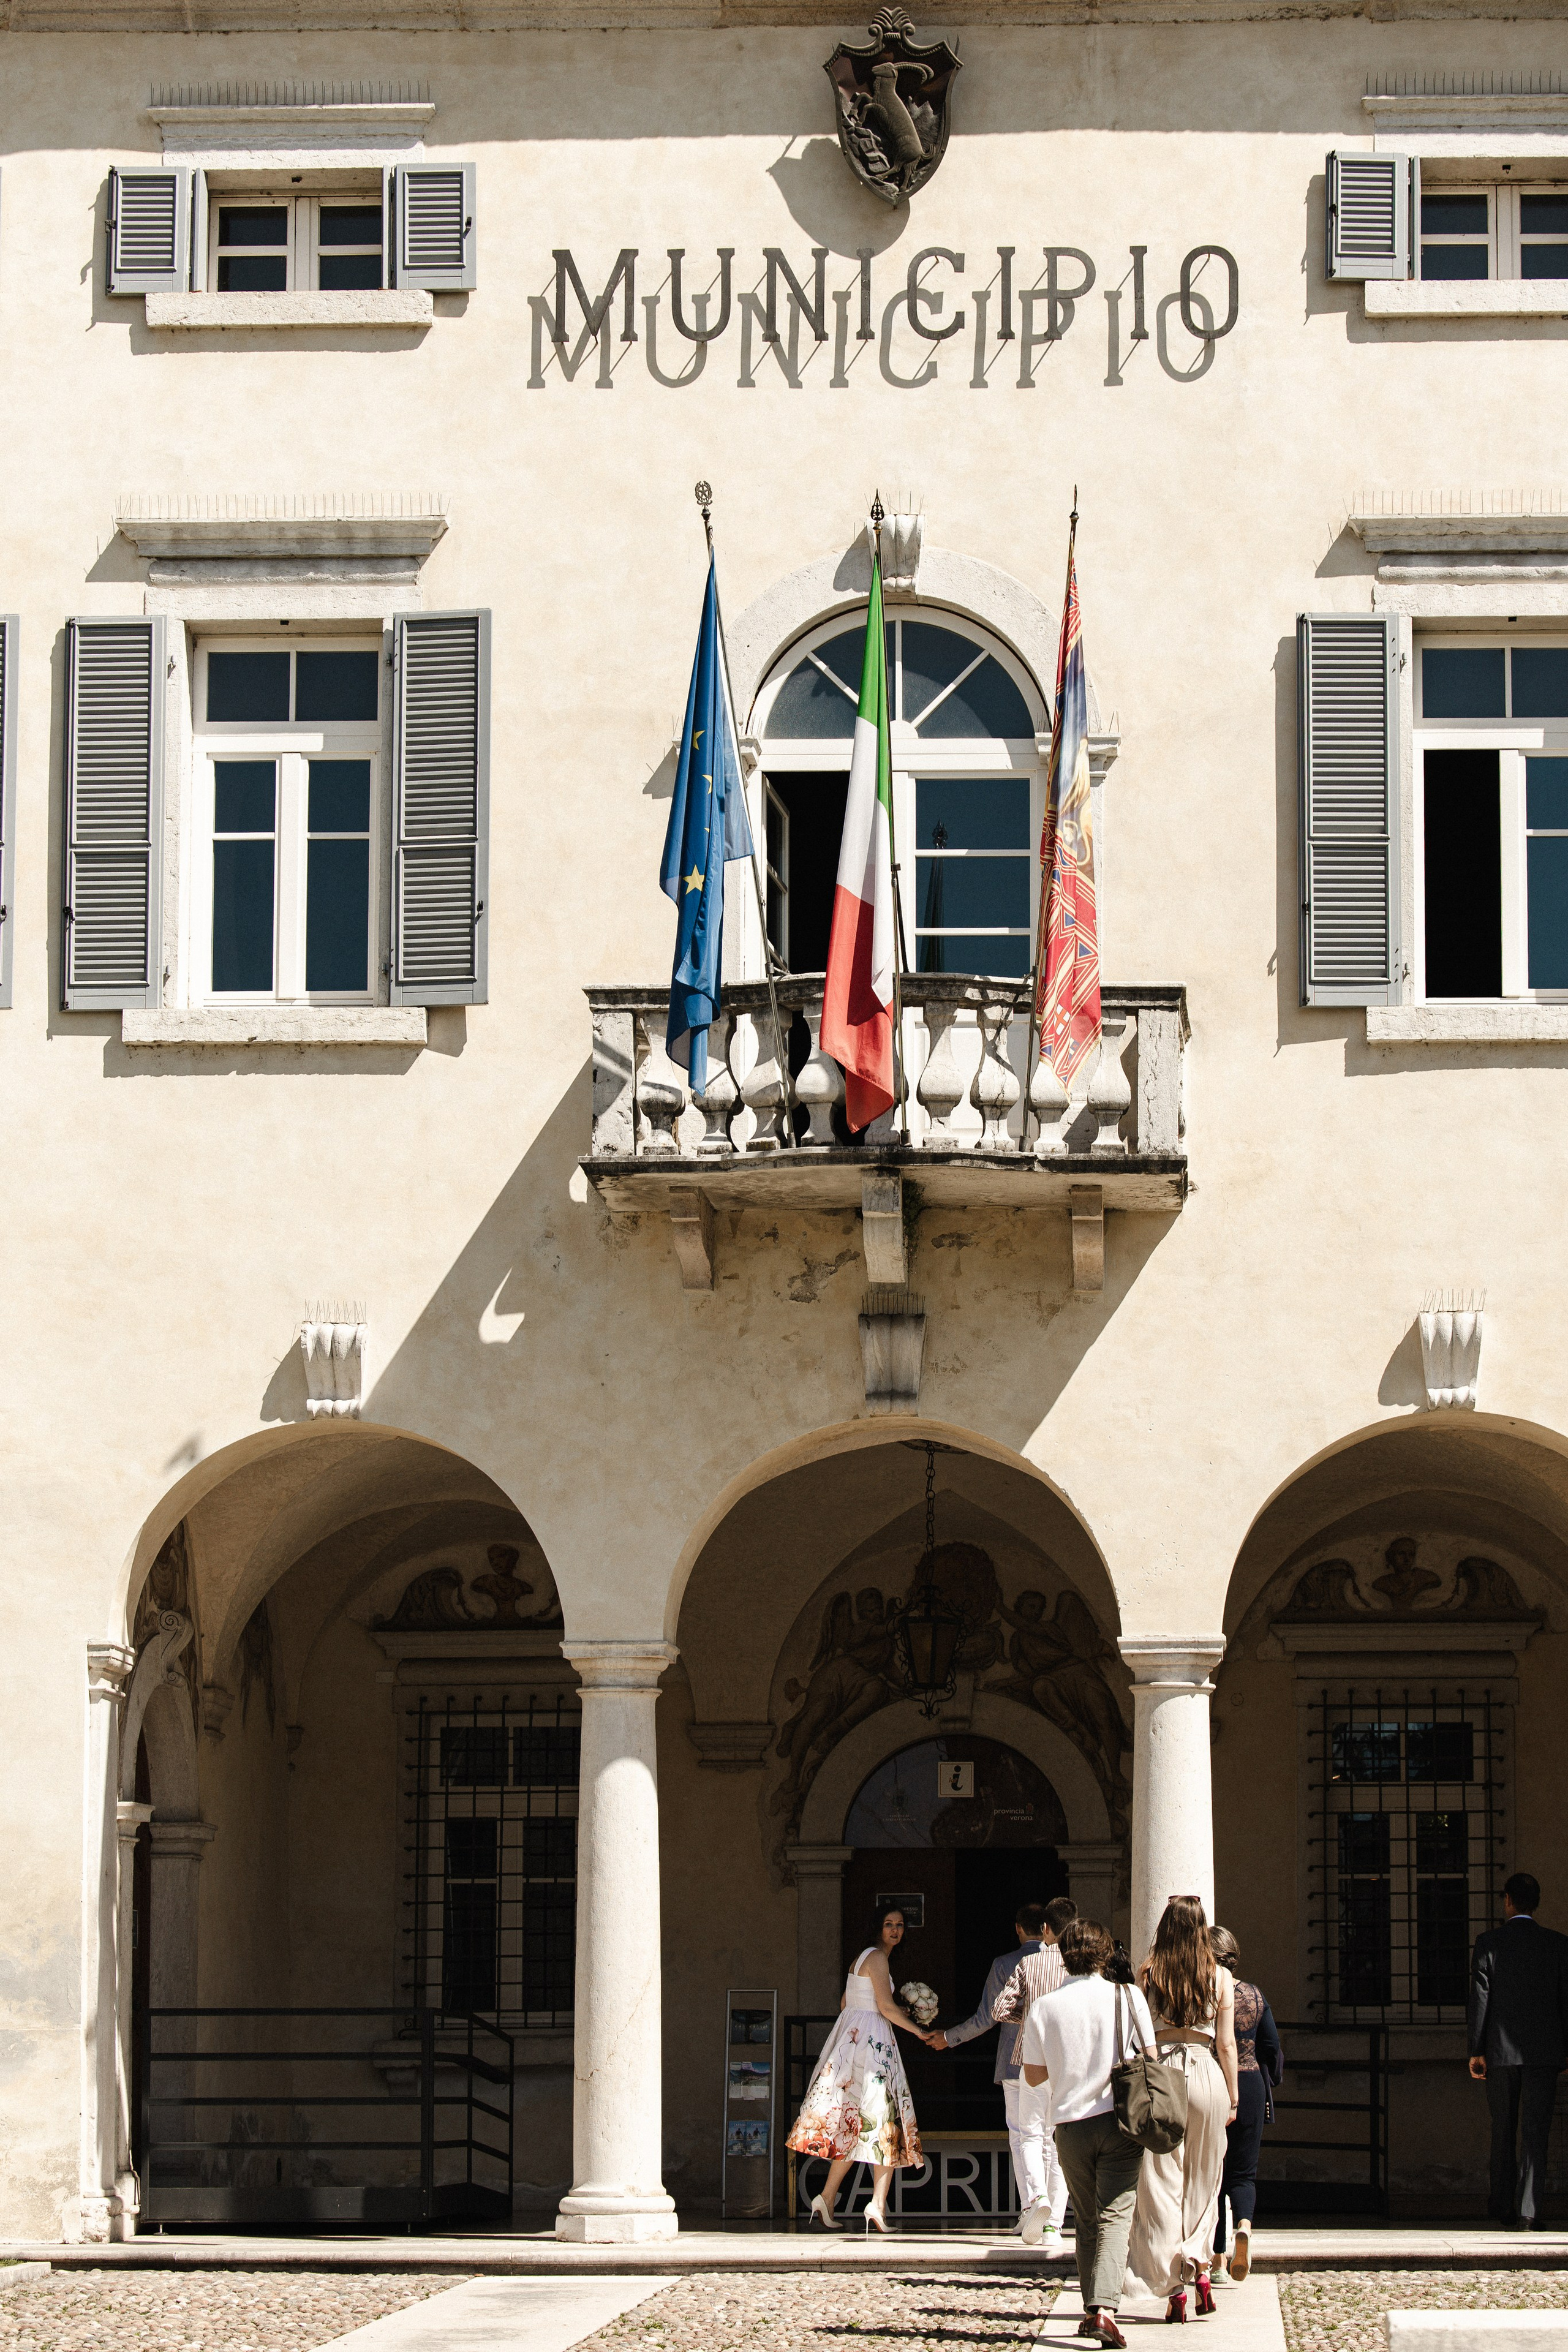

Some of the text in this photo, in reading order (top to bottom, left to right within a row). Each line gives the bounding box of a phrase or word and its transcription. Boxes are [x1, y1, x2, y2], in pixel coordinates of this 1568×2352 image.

[552, 245, 1238, 343] MUNICIPIO
[993, 1807, 1025, 1816] provincia
[798, 2151, 1072, 2214] CAPRI
